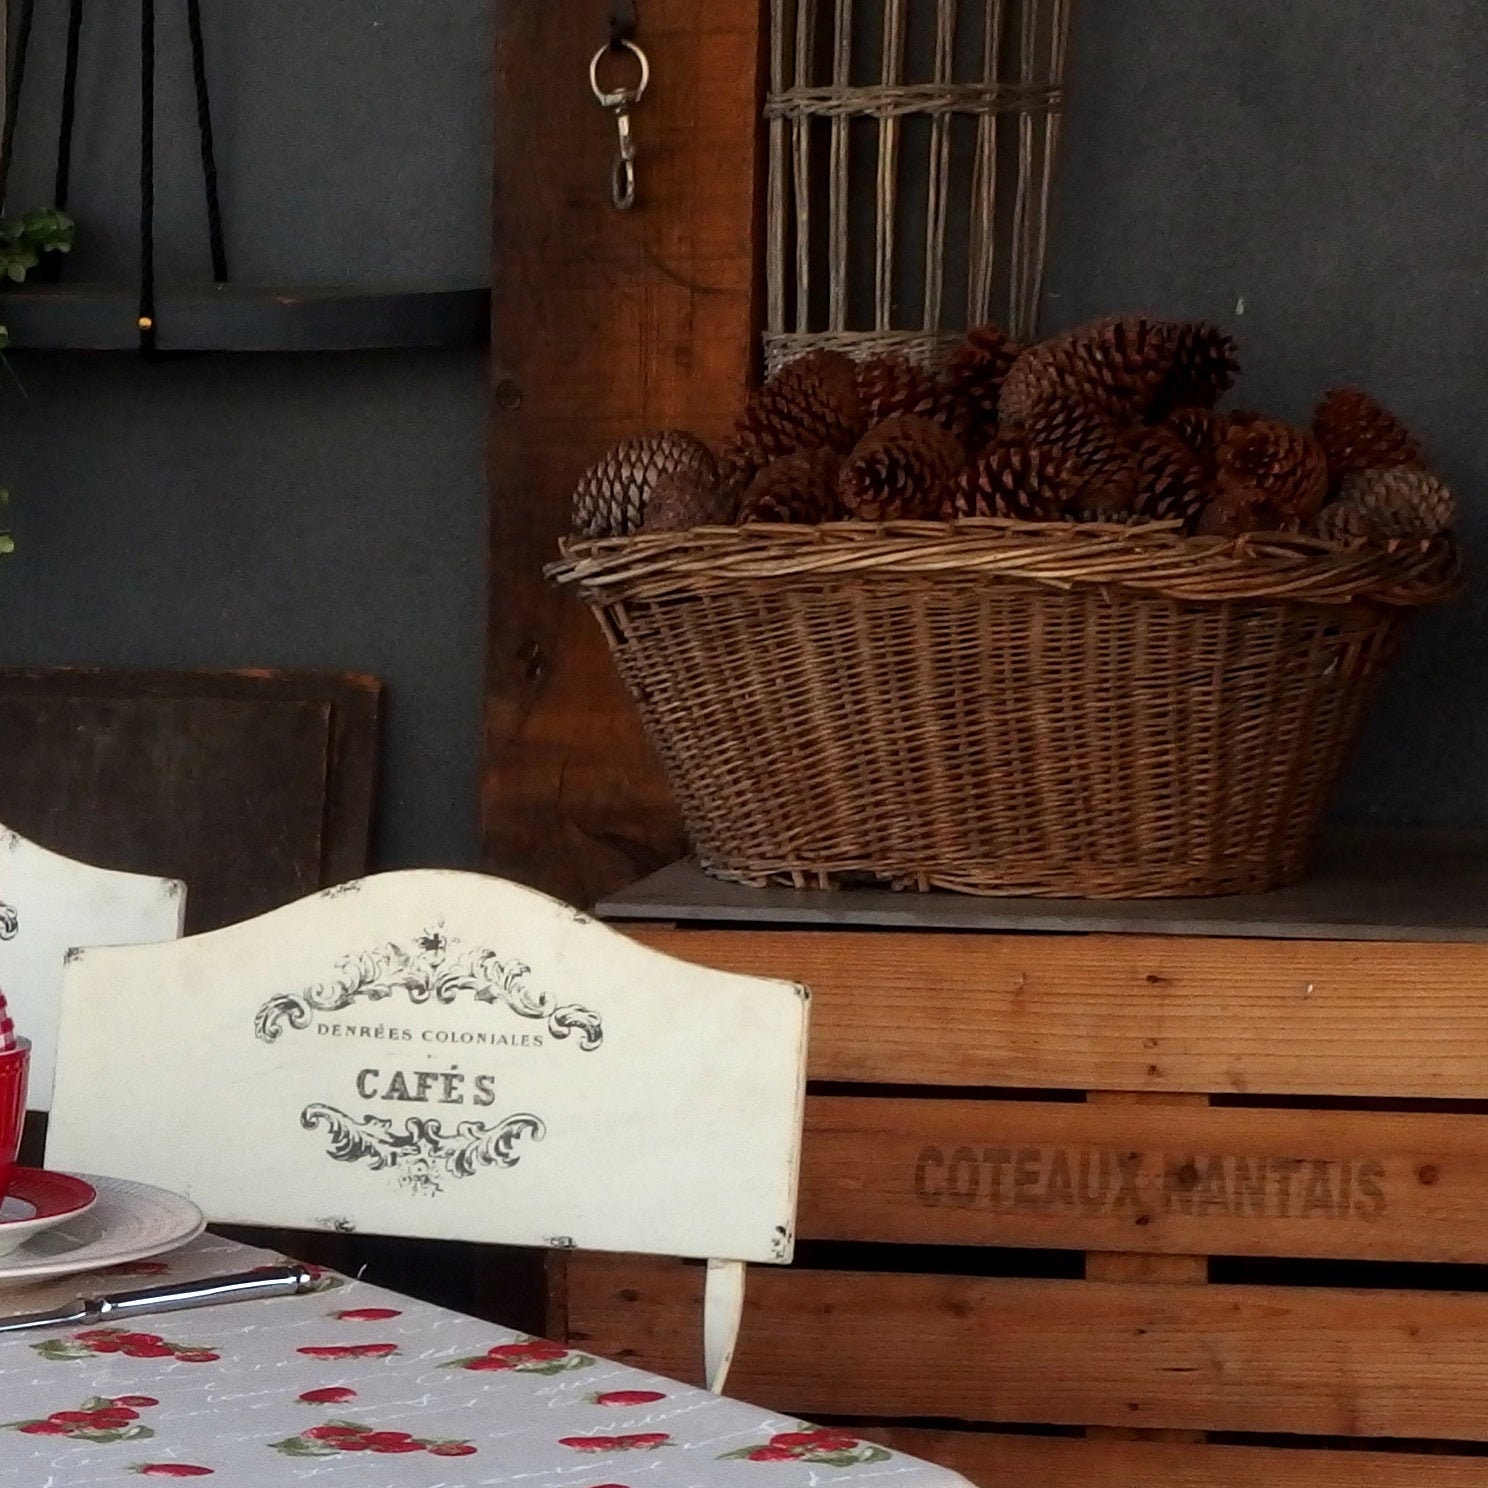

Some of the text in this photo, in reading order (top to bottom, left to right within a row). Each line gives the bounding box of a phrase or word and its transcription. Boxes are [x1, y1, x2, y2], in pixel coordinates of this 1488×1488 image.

[317, 1023, 544, 1048] DENRÉES COLONIALES
[356, 1065, 496, 1106] CAFÉS
[914, 1144, 1144, 1211] COTEAUX
